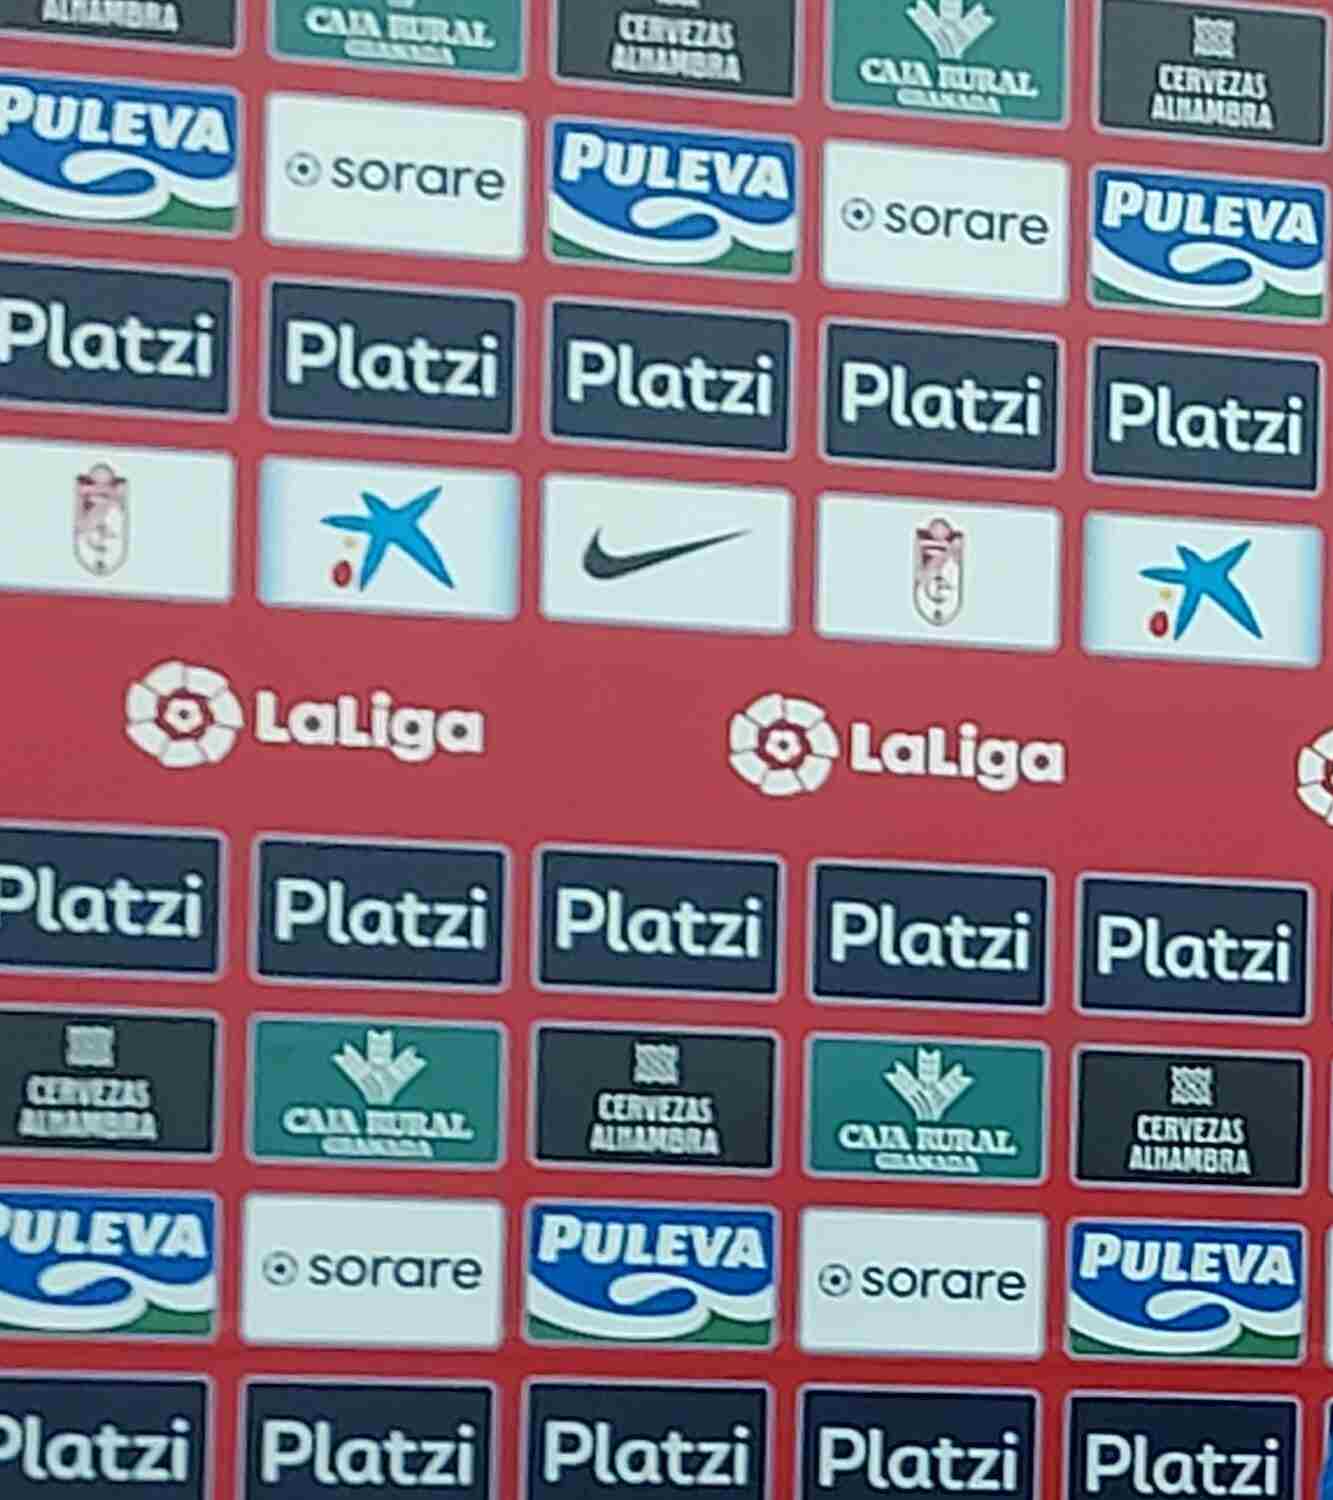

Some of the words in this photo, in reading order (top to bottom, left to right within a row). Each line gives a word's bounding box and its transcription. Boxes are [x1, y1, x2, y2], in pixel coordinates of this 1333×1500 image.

[619, 12, 735, 49] CERVEZAS
[610, 42, 742, 82] ALHAMBRA
[859, 58, 932, 89] CAJA
[939, 65, 1039, 99] RURAL
[1158, 64, 1268, 100] CERVEZAS
[0, 83, 231, 154] PULEVA
[899, 90, 1002, 114] GRANADA
[1150, 94, 1274, 131] ALHAMBRA
[332, 157, 505, 200] sorare
[561, 133, 788, 199] PULEVA
[884, 203, 1048, 245] sorare
[1103, 180, 1317, 244] PULEVA
[0, 298, 214, 379] Platzi
[287, 321, 498, 397] Platzi
[568, 341, 772, 416] Platzi
[843, 362, 1041, 435] Platzi
[1110, 383, 1302, 455] Platzi
[257, 691, 483, 761] LaLiga
[852, 723, 1064, 791] LaLiga
[0, 863, 203, 938] Platzi
[276, 878, 486, 949] Platzi
[557, 888, 761, 957] Platzi
[832, 902, 1029, 970] Platzi
[1098, 916, 1290, 982] Platzi
[27, 1074, 151, 1109] CERVEZAS
[597, 1091, 714, 1125] CERVEZAS
[589, 1122, 721, 1157] ALHAMBRA
[839, 1122, 910, 1152] CAJA
[916, 1128, 1017, 1156] RURAL
[1137, 1115, 1245, 1145] CERVEZAS
[875, 1152, 980, 1175] GRANADA
[1129, 1144, 1251, 1178] ALHAMBRA
[0, 1204, 208, 1259] ULEVA
[538, 1214, 765, 1268] PULEVA
[1080, 1233, 1295, 1285] PULEVA
[309, 1254, 482, 1289] sorare
[862, 1267, 1026, 1301] sorare
[262, 1420, 474, 1485] Platzi
[545, 1421, 749, 1485] Platzi
[819, 1427, 1017, 1490] Platzi
[1087, 1434, 1278, 1495] Platzi
